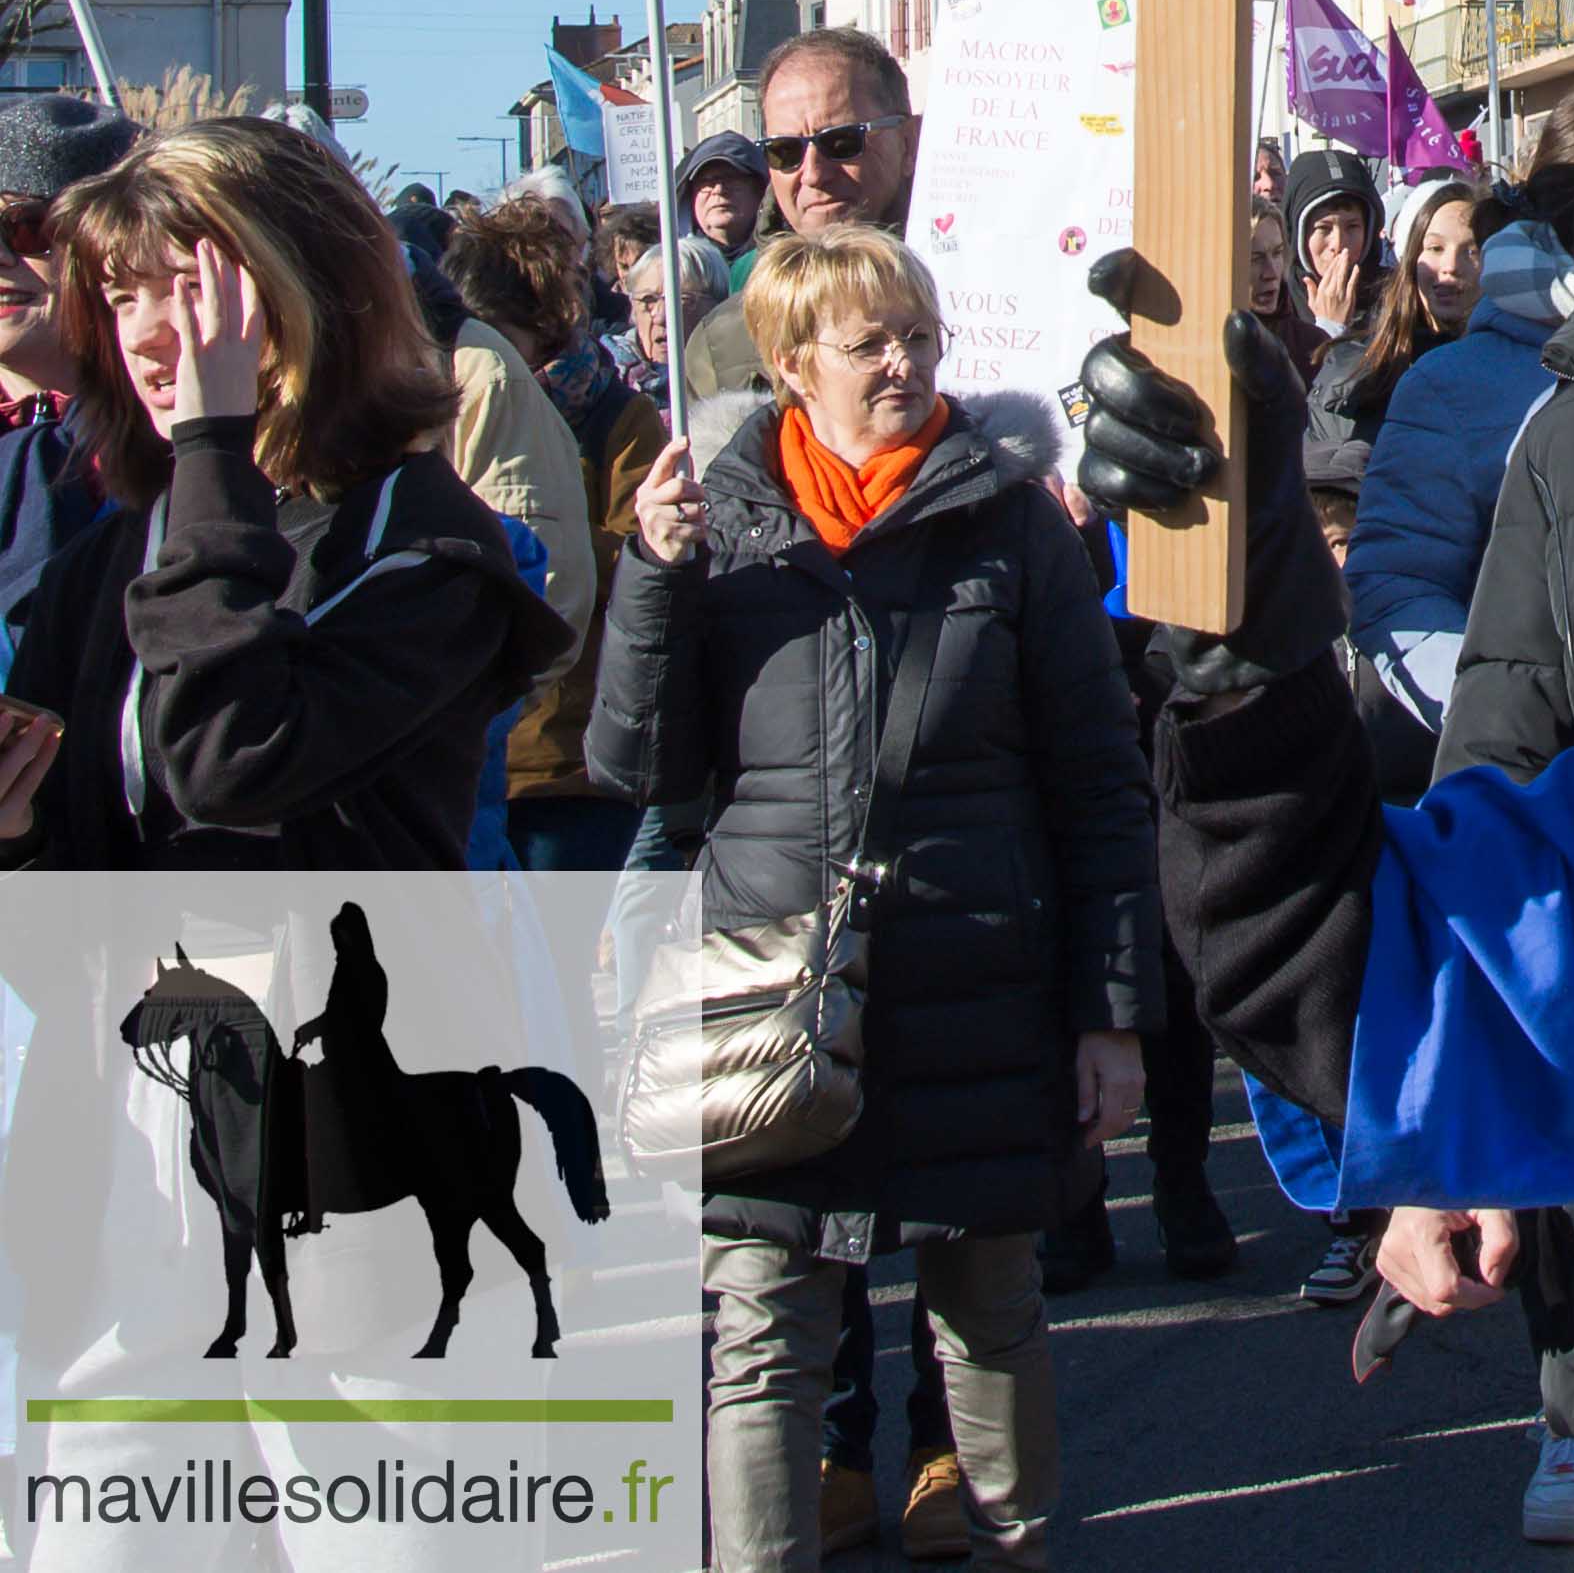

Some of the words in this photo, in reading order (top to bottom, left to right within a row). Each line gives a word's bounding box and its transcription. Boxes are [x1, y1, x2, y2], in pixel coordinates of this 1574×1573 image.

[959, 39, 1064, 62] MACRON
[944, 66, 1072, 93] FOSSOYEUR
[970, 97, 1000, 117] DE
[1008, 98, 1039, 121] LA
[954, 125, 1050, 152] FRANCE
[948, 290, 1018, 316] VOUS
[950, 324, 1042, 352] PASSEZ
[956, 357, 1002, 381] LES
